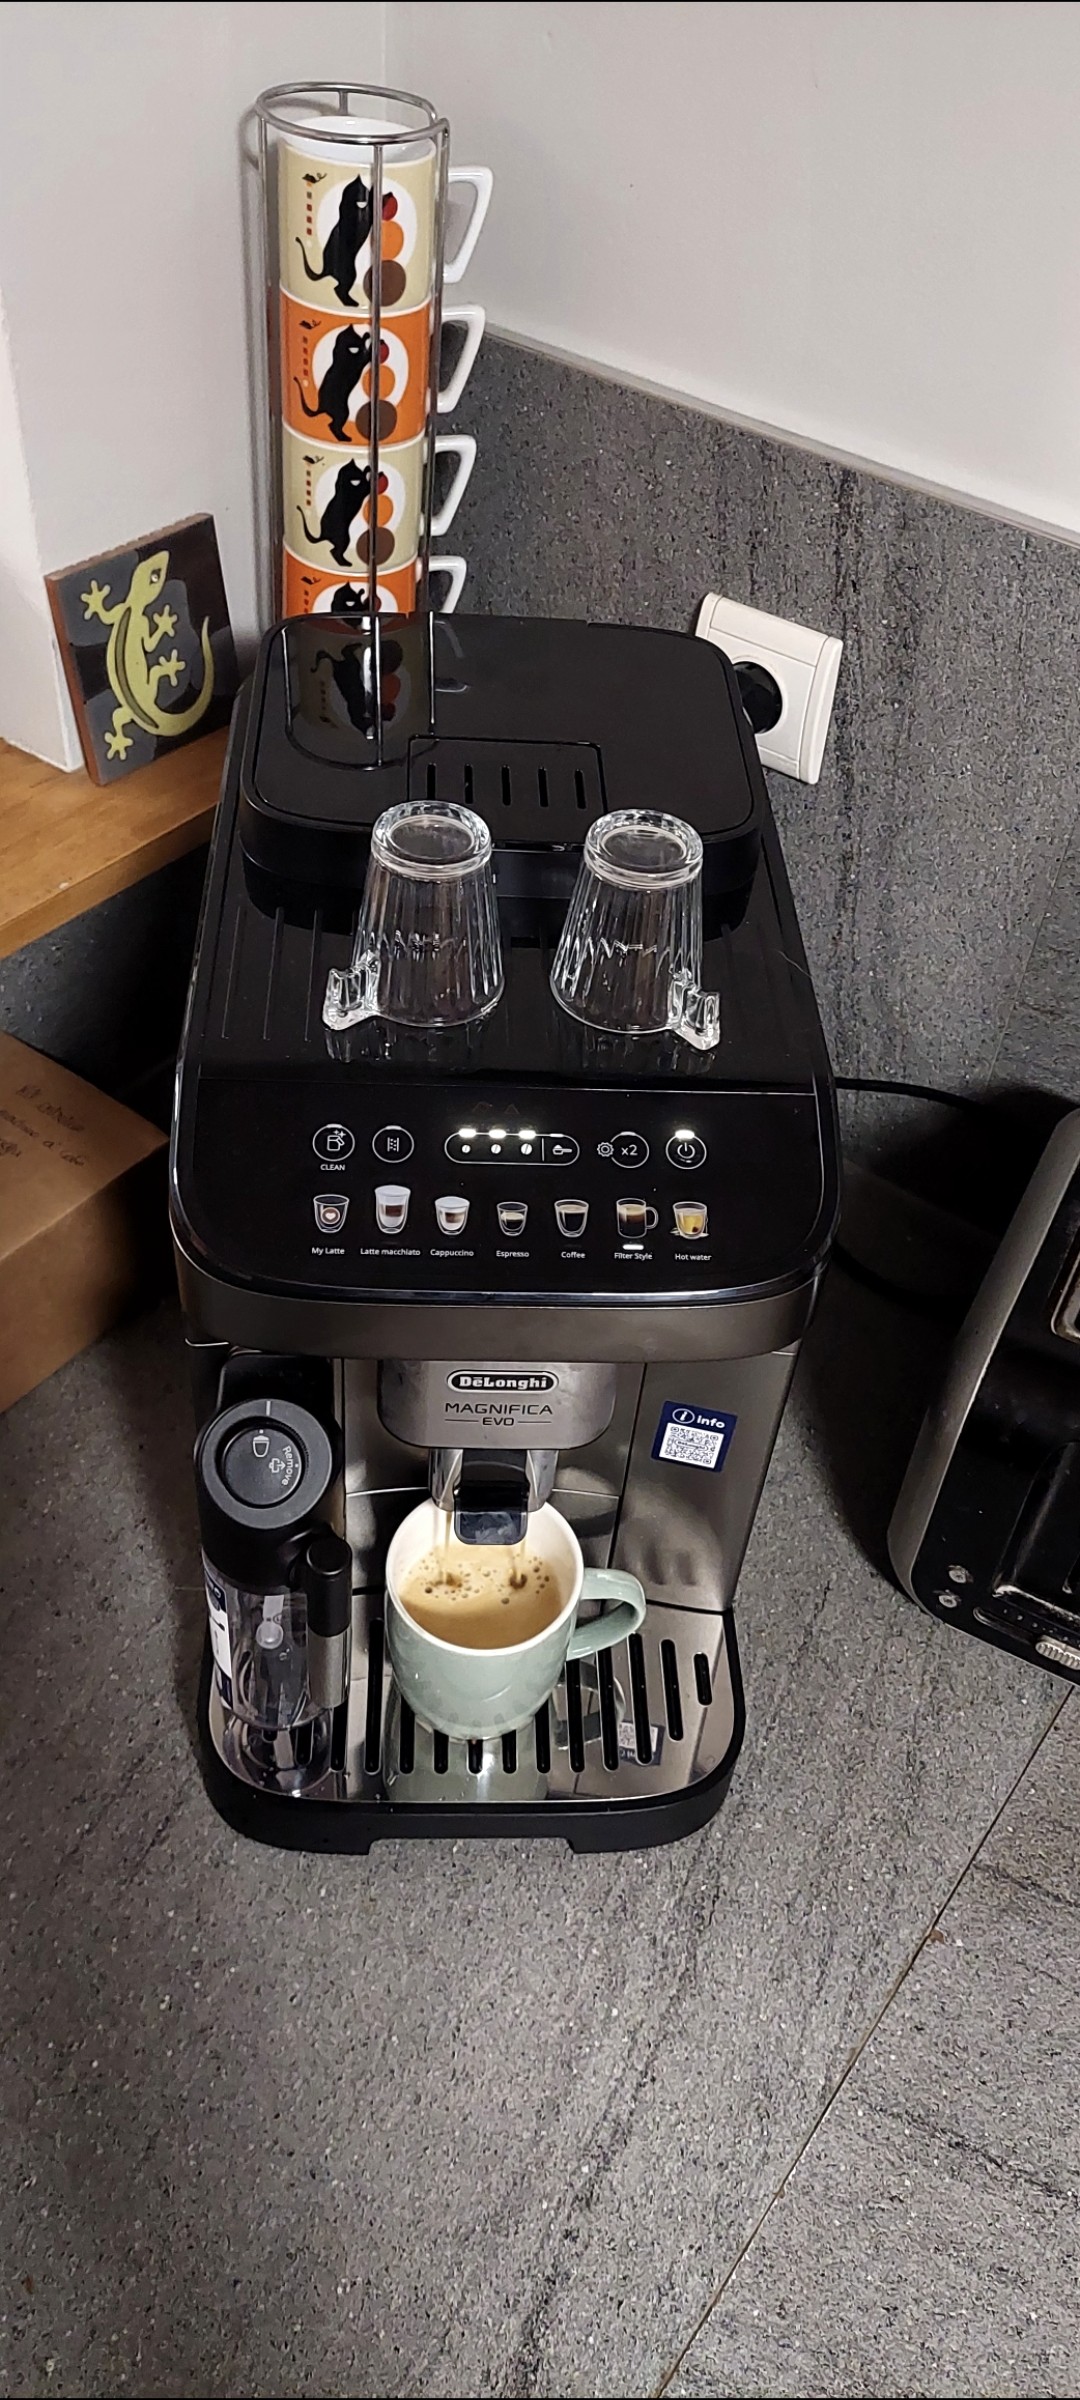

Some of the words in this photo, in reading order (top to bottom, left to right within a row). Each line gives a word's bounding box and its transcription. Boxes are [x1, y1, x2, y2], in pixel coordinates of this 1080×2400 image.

[621, 1144, 638, 1156] x2
[311, 1247, 324, 1256] My
[325, 1247, 345, 1255] Latte
[381, 1248, 421, 1256] macchiato
[430, 1249, 474, 1257] Cappuccino
[496, 1250, 530, 1258] Espresso
[561, 1251, 586, 1259] Coffee
[614, 1252, 635, 1260] Filter
[635, 1252, 653, 1261] Style
[675, 1253, 689, 1261] Hot
[445, 1403, 553, 1415] MAGNIFICA
[482, 1417, 515, 1426] EVO
[696, 1415, 725, 1429] info
[282, 1445, 294, 1486] Remove
